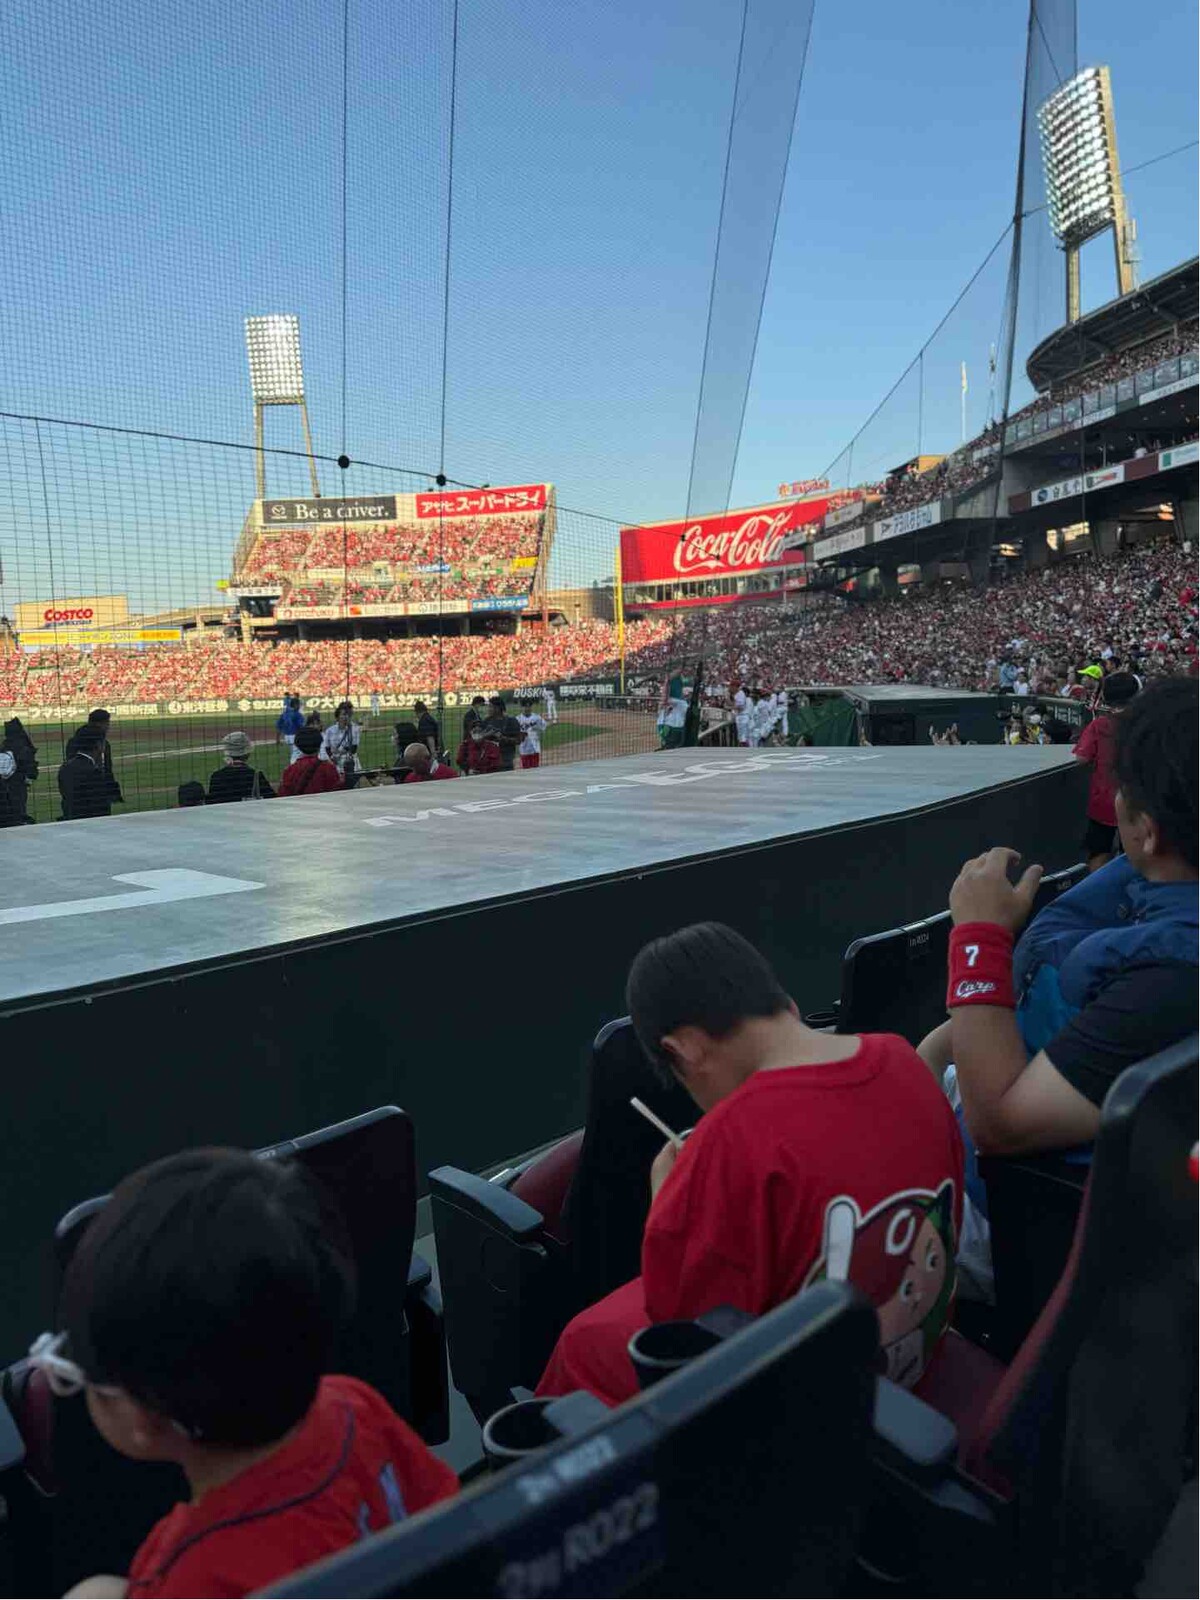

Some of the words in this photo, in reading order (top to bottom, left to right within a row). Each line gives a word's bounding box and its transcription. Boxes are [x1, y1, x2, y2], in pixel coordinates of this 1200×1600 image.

[295, 503, 319, 519] Be
[322, 509, 333, 519] a
[336, 501, 390, 519] driver.
[965, 944, 979, 967] 7
[955, 980, 997, 999] Carp
